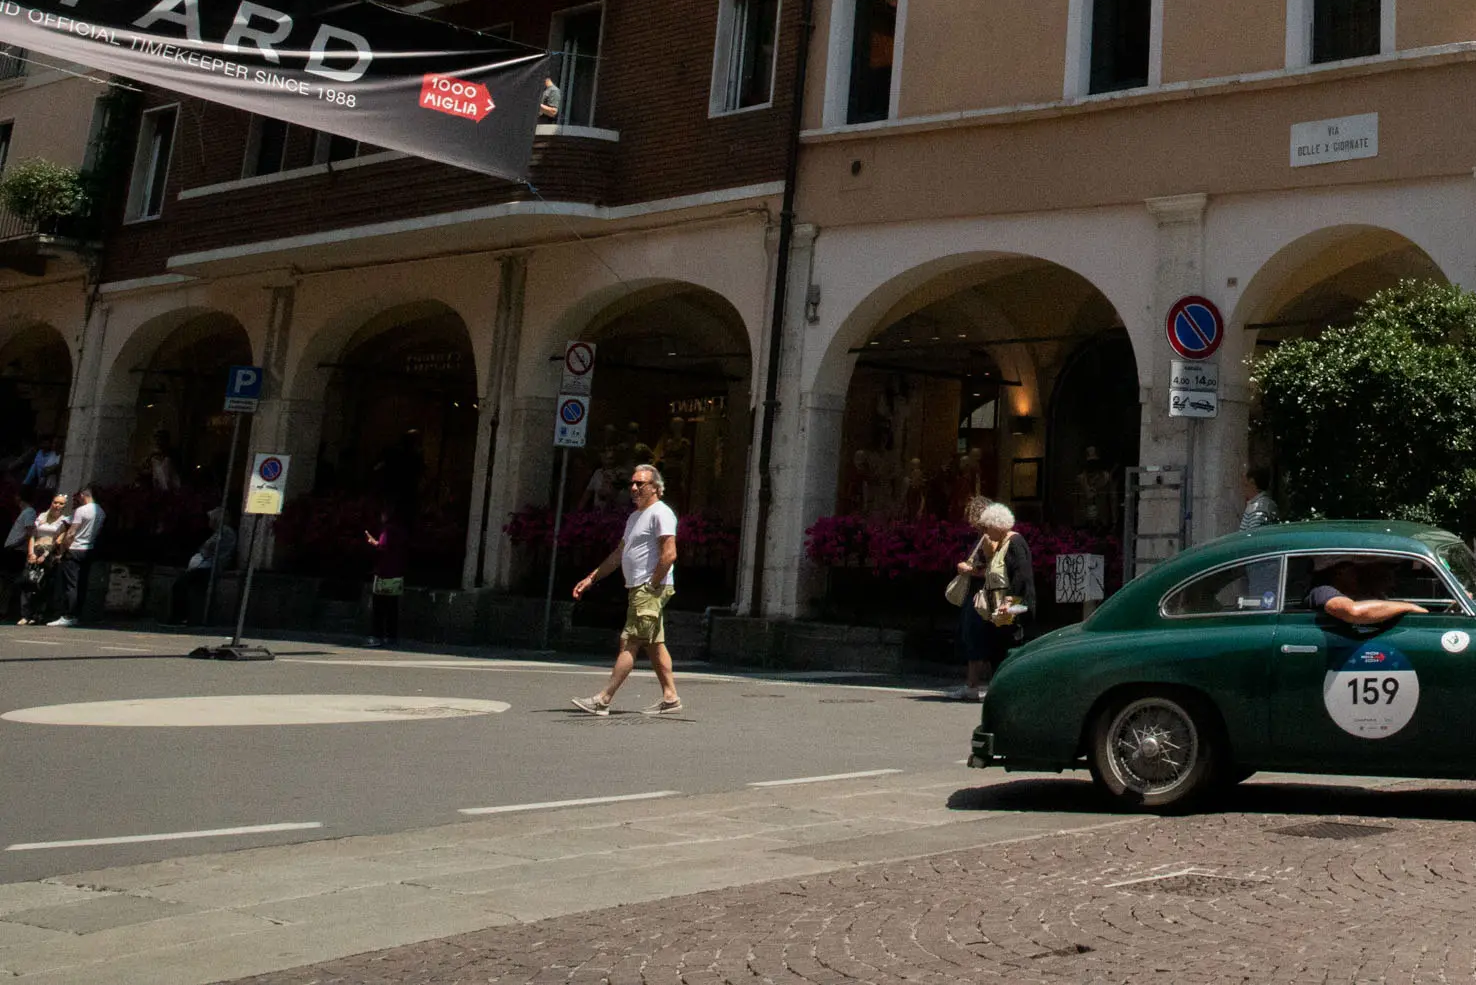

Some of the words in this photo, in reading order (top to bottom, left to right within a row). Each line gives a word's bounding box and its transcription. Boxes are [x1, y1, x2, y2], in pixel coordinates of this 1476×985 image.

[28, 8, 121, 46] OFFICIAL
[131, 36, 249, 80] TIMEKEEPER
[254, 70, 311, 96] SINCE
[317, 87, 357, 108] 1988
[431, 77, 477, 98] 1000
[424, 92, 477, 116] MIGLIA
[1327, 125, 1340, 137] VIA
[1297, 143, 1321, 157] DELLE
[1324, 142, 1330, 153] X
[1333, 137, 1369, 153] GIORNATE
[234, 369, 257, 393] P
[1347, 677, 1400, 705] 159
